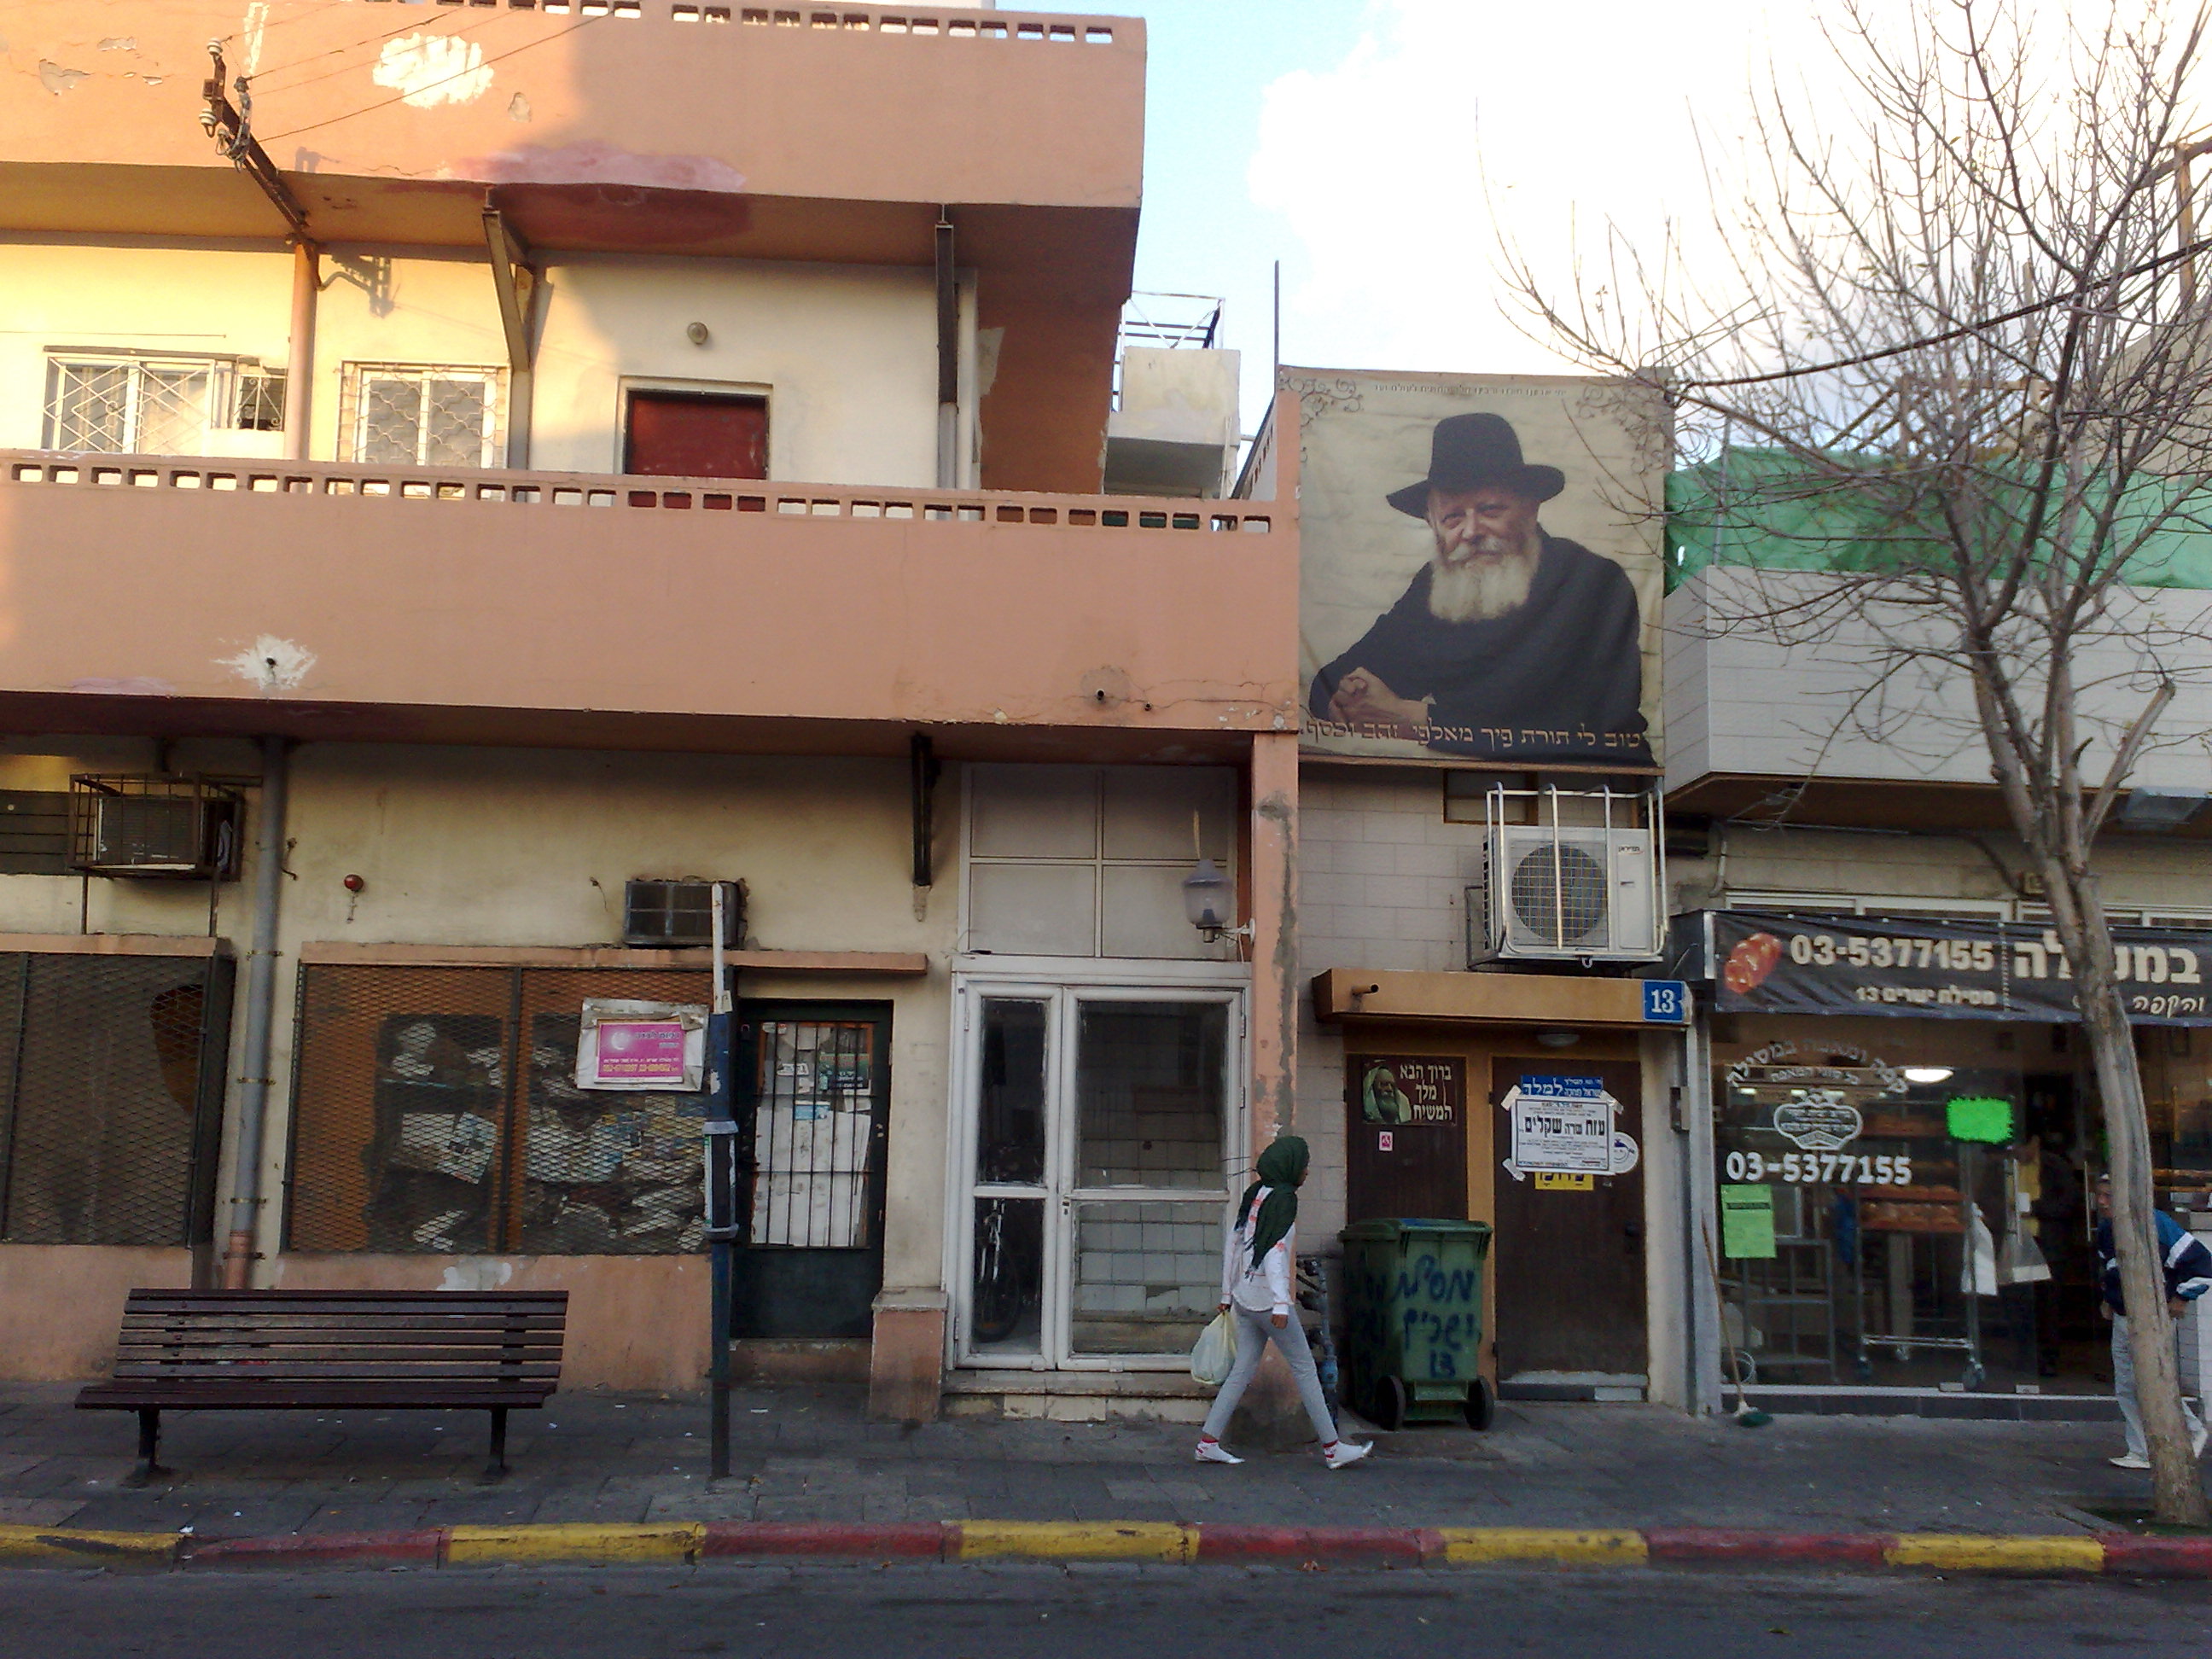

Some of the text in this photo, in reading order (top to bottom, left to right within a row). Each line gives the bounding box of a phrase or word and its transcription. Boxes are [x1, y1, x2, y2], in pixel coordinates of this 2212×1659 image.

[1361, 722, 1398, 740] זהב
[1412, 716, 1474, 746] מאלפי
[1481, 727, 1514, 752] פיך
[1521, 729, 1569, 746] תורת
[1577, 722, 1597, 746] לי
[1604, 731, 1641, 748] טוב
[1790, 934, 1995, 972] 03-5377155
[2014, 929, 2201, 984] במלה
[1650, 989, 1675, 1014] 13
[1855, 986, 1878, 1002] 13
[1400, 1063, 1452, 1084] ברוך הבא
[1415, 1080, 1437, 1104] מלך
[1522, 1076, 1563, 1097] למלך
[1412, 1104, 1452, 1121] המשיח
[1524, 1115, 1563, 1138] שקלים
[1726, 1150, 1912, 1185] 03-5377155
